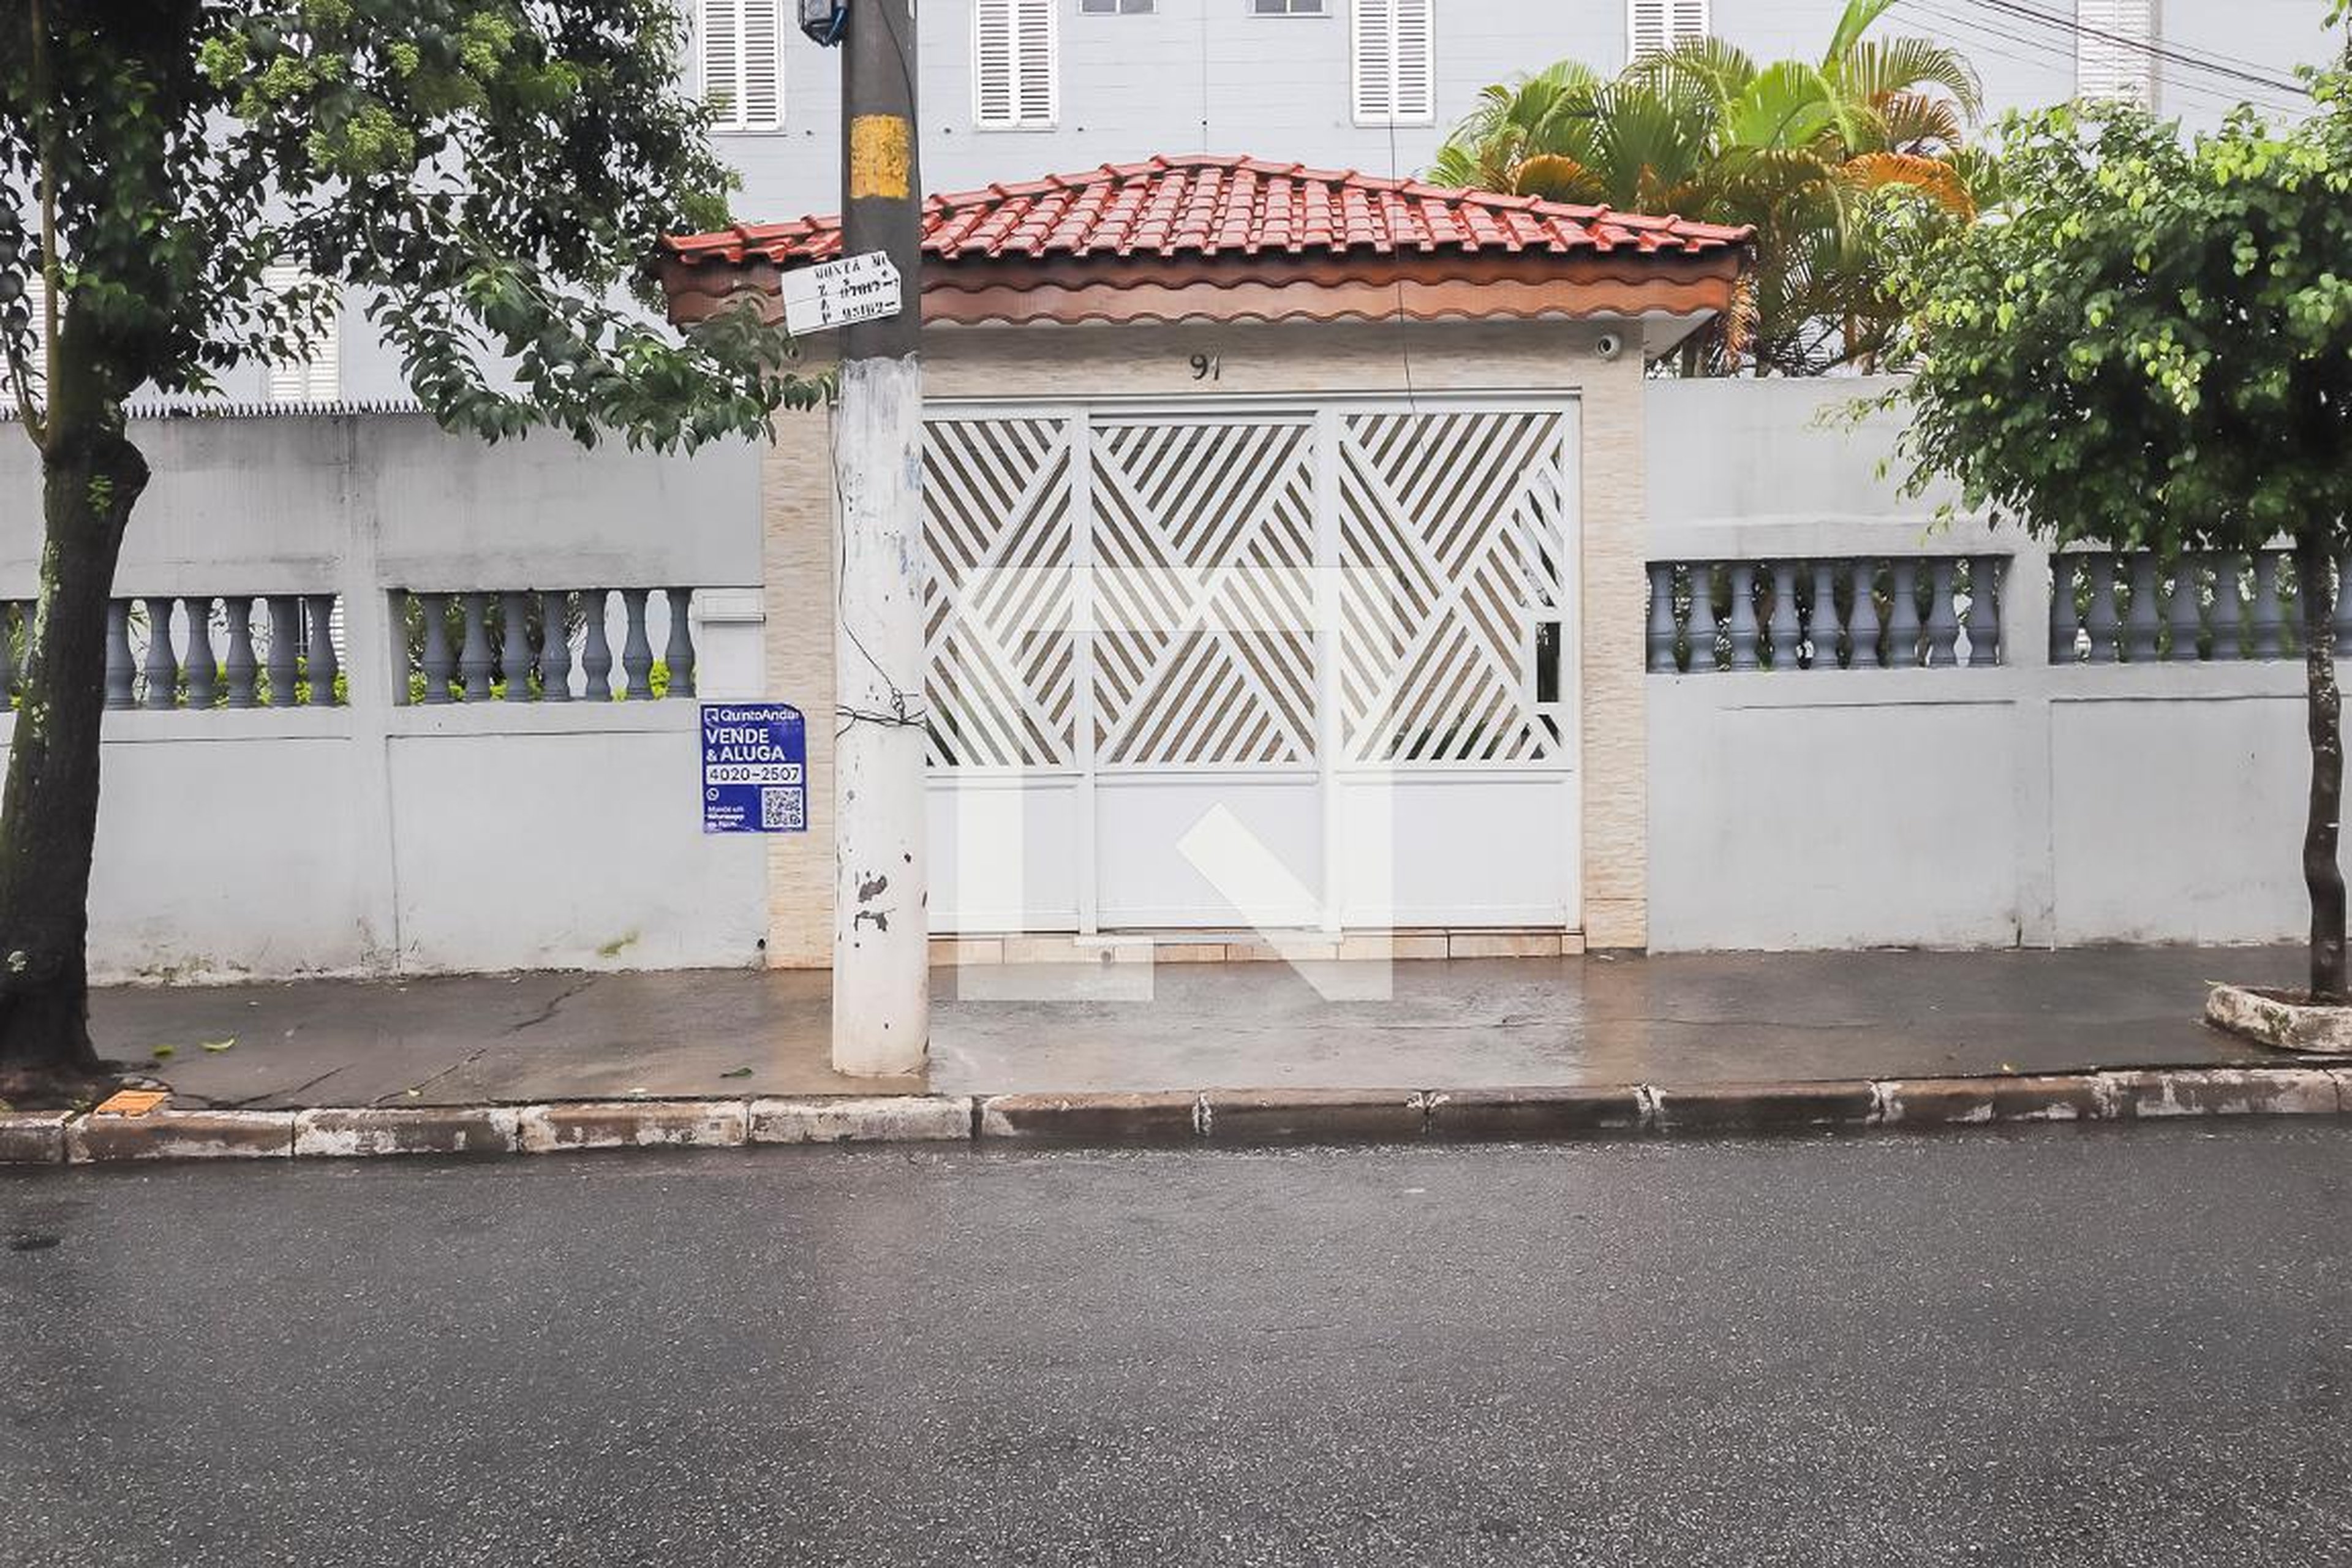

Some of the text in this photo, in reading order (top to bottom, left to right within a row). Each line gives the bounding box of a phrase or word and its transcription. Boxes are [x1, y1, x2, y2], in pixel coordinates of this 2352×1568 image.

[1190, 355, 1219, 381] 91
[705, 728, 769, 744] VENDE
[706, 745, 786, 762] & ALUGA
[710, 767, 799, 781] 4020-2507
